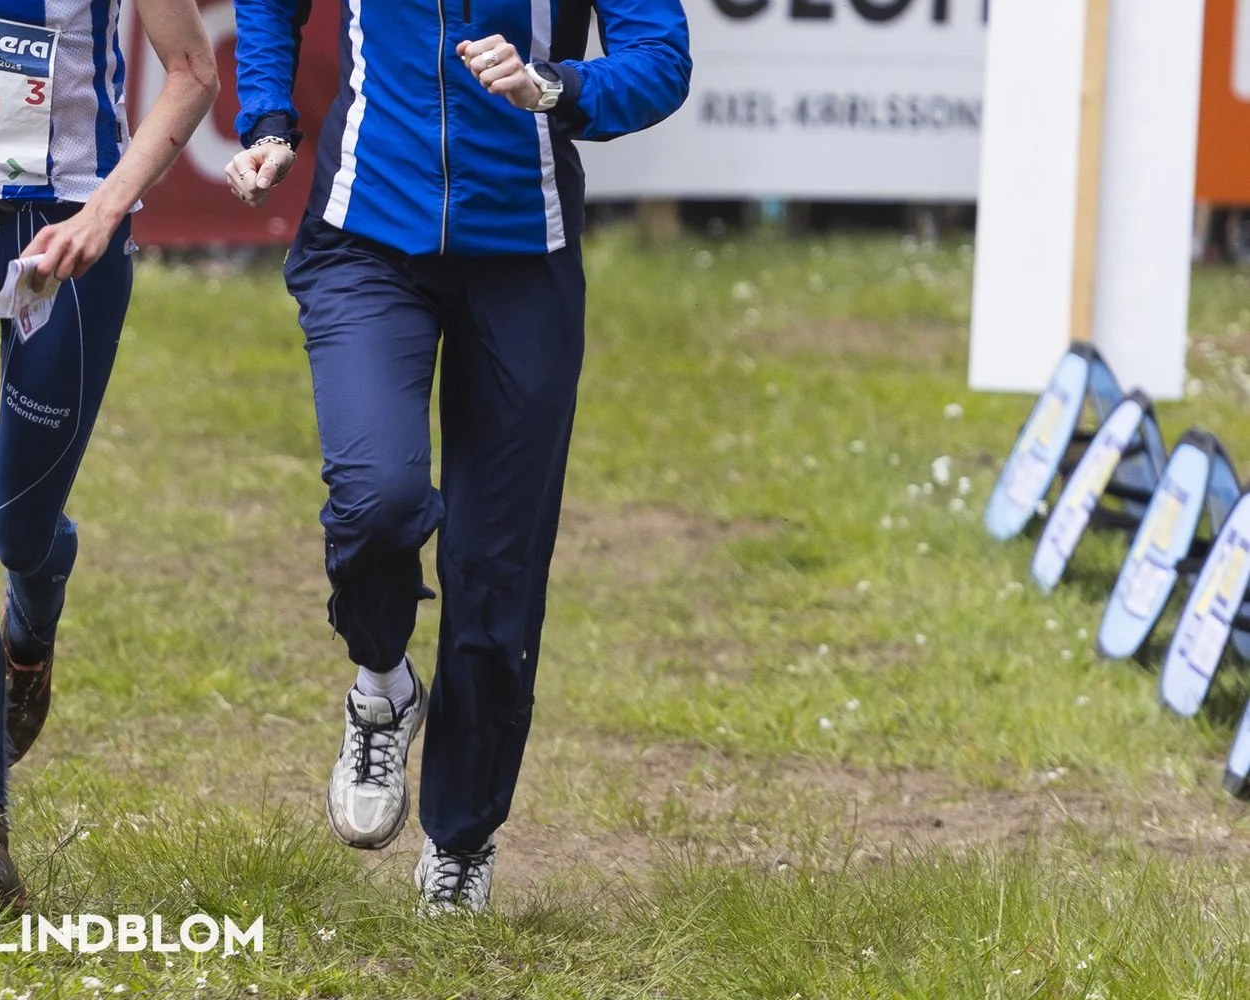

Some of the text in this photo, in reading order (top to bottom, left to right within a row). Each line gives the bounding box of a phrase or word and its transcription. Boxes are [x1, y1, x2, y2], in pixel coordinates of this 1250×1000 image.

[25, 80, 46, 105] 3
[6, 383, 71, 417] IFK Göteborg
[7, 396, 61, 428] Orientering
